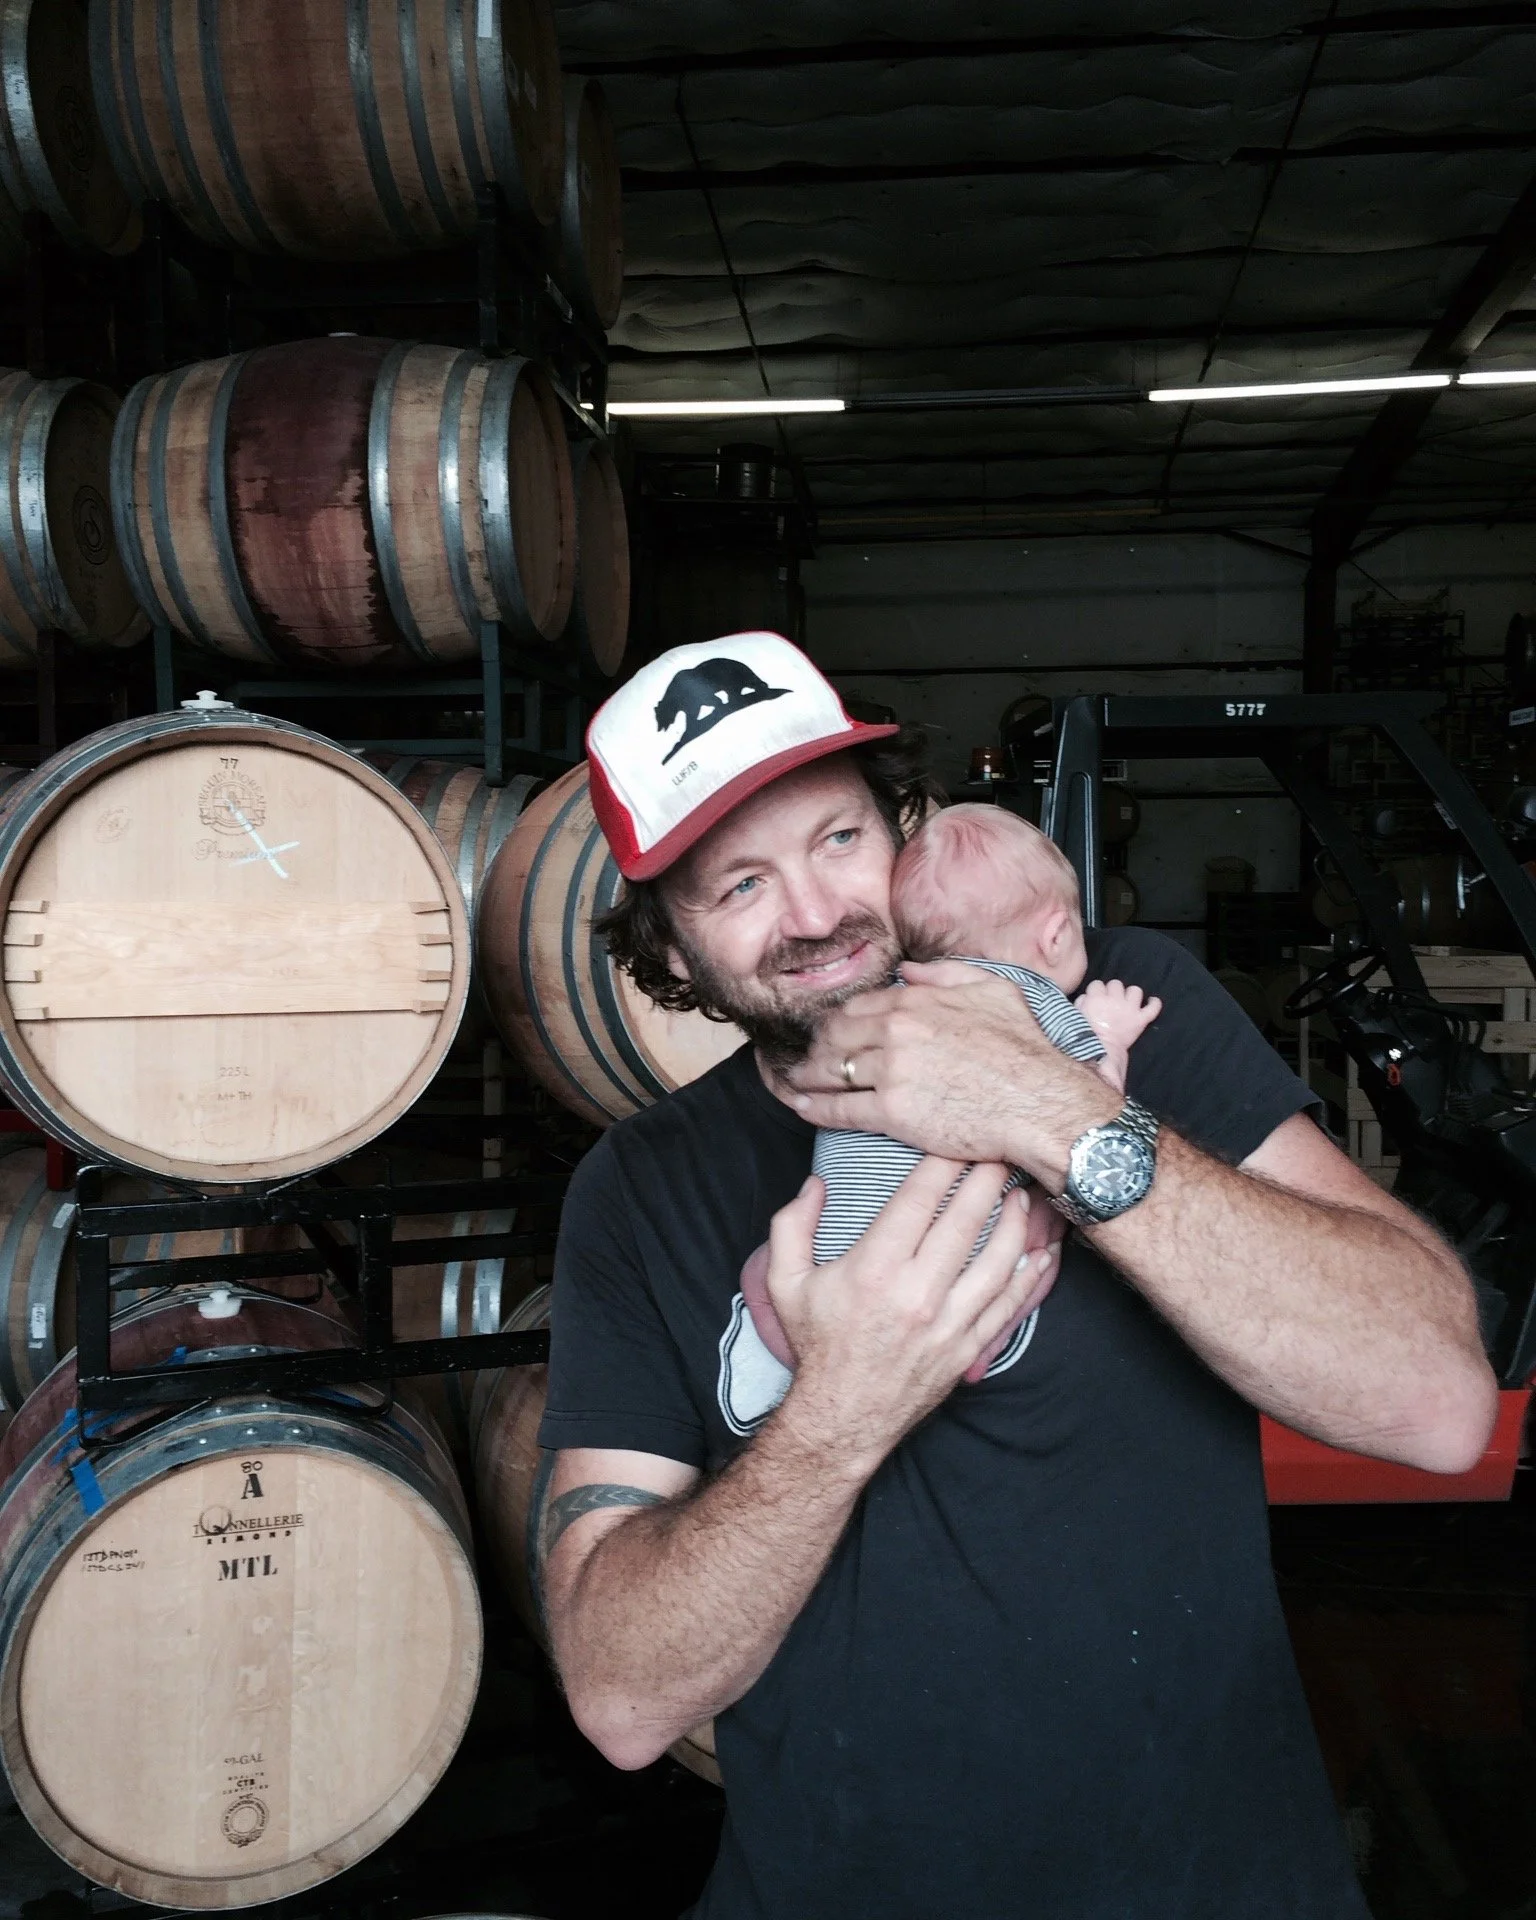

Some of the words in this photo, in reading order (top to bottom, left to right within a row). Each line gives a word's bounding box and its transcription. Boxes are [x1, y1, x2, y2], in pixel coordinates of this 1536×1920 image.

[220, 757, 239, 769] 77
[240, 1473, 264, 1500] A
[217, 1554, 279, 1582] MTL
